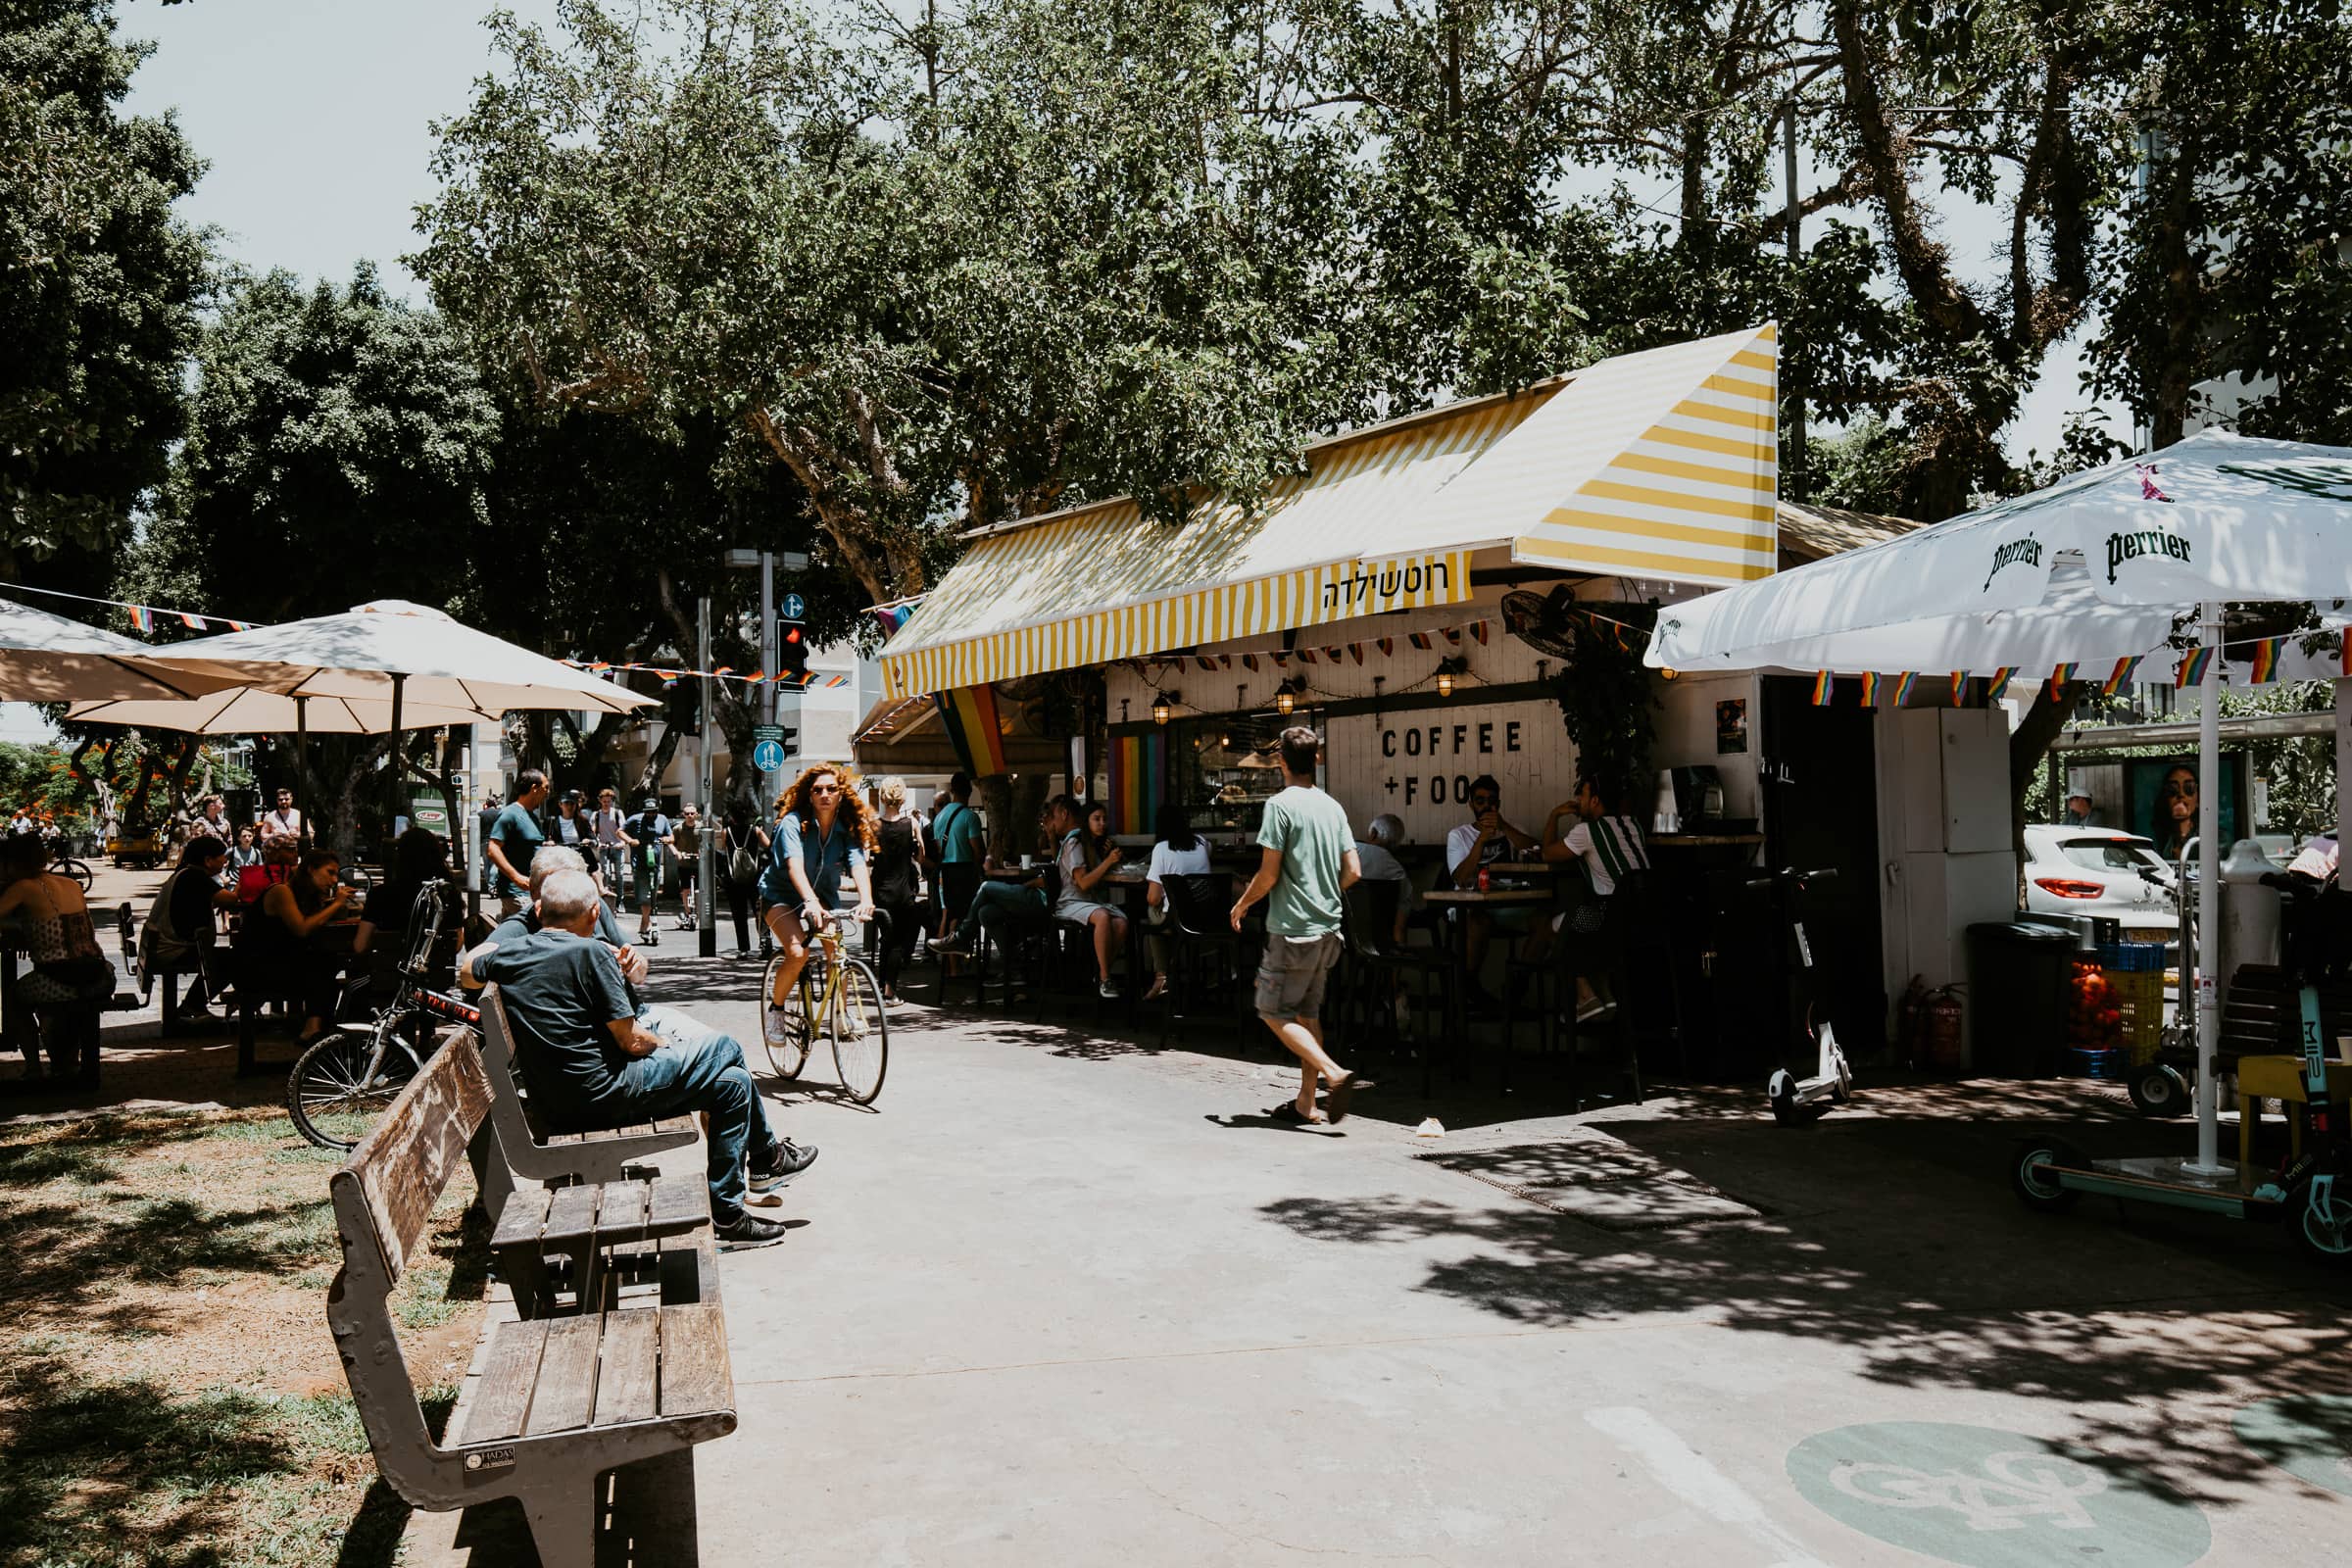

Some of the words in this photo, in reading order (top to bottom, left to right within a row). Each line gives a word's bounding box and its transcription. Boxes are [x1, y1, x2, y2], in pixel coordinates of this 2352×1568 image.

[1984, 530, 2042, 593] perrier
[2105, 524, 2191, 585] perrier
[1324, 563, 1448, 609] רוטשילדה
[1382, 721, 1521, 759] COFFEE
[1384, 774, 1472, 806] +FOO
[481, 1448, 514, 1461] HADAS
